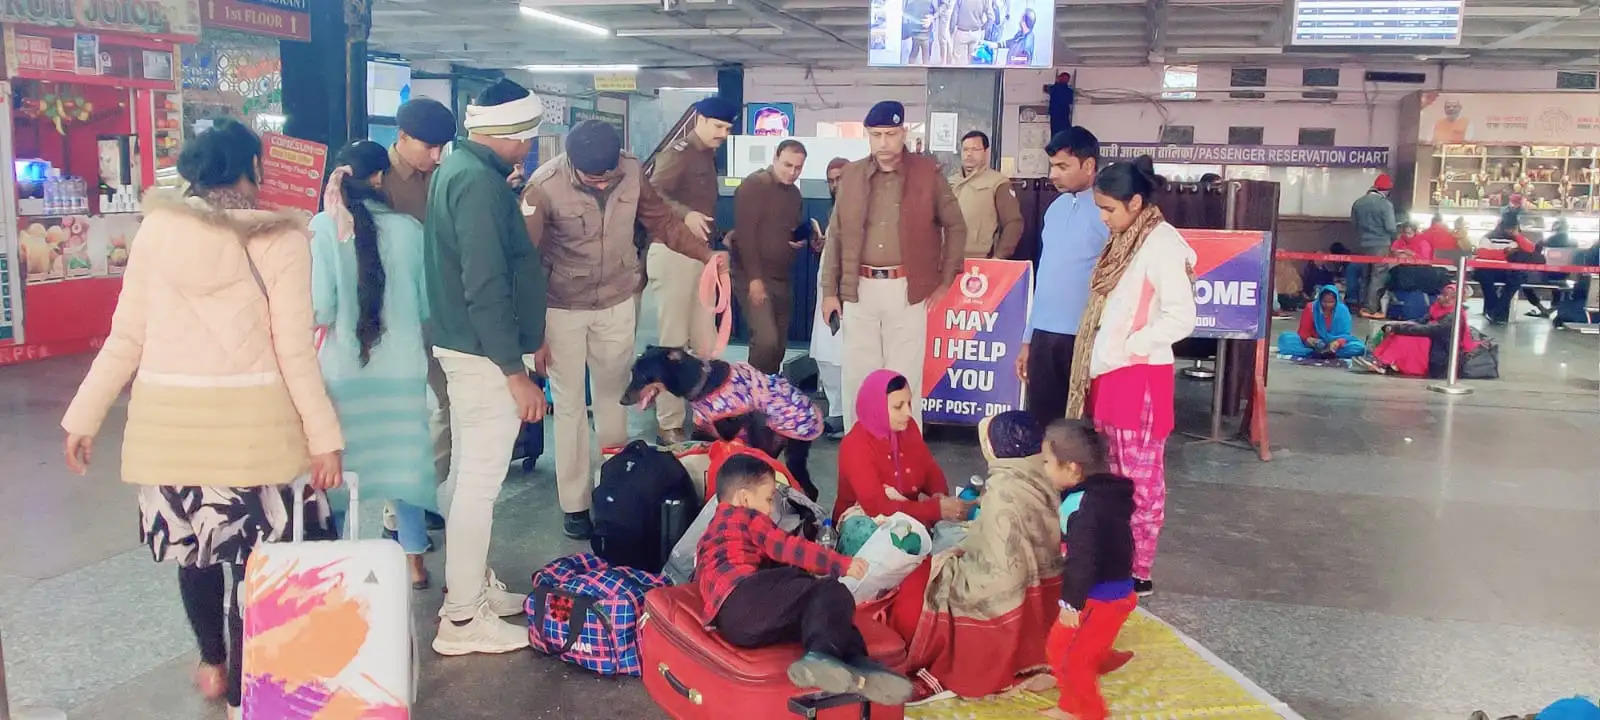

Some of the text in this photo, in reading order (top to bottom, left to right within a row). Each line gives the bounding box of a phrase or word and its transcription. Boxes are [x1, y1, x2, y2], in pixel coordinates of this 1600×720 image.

[245, 9, 282, 28] FLOOR
[1268, 149, 1346, 163] RESERVATION
[1349, 151, 1389, 164] CHART
[946, 309, 999, 332] MAY
[933, 337, 1006, 362] I HELP
[947, 367, 994, 391] YOU
[920, 397, 943, 412] RPF
